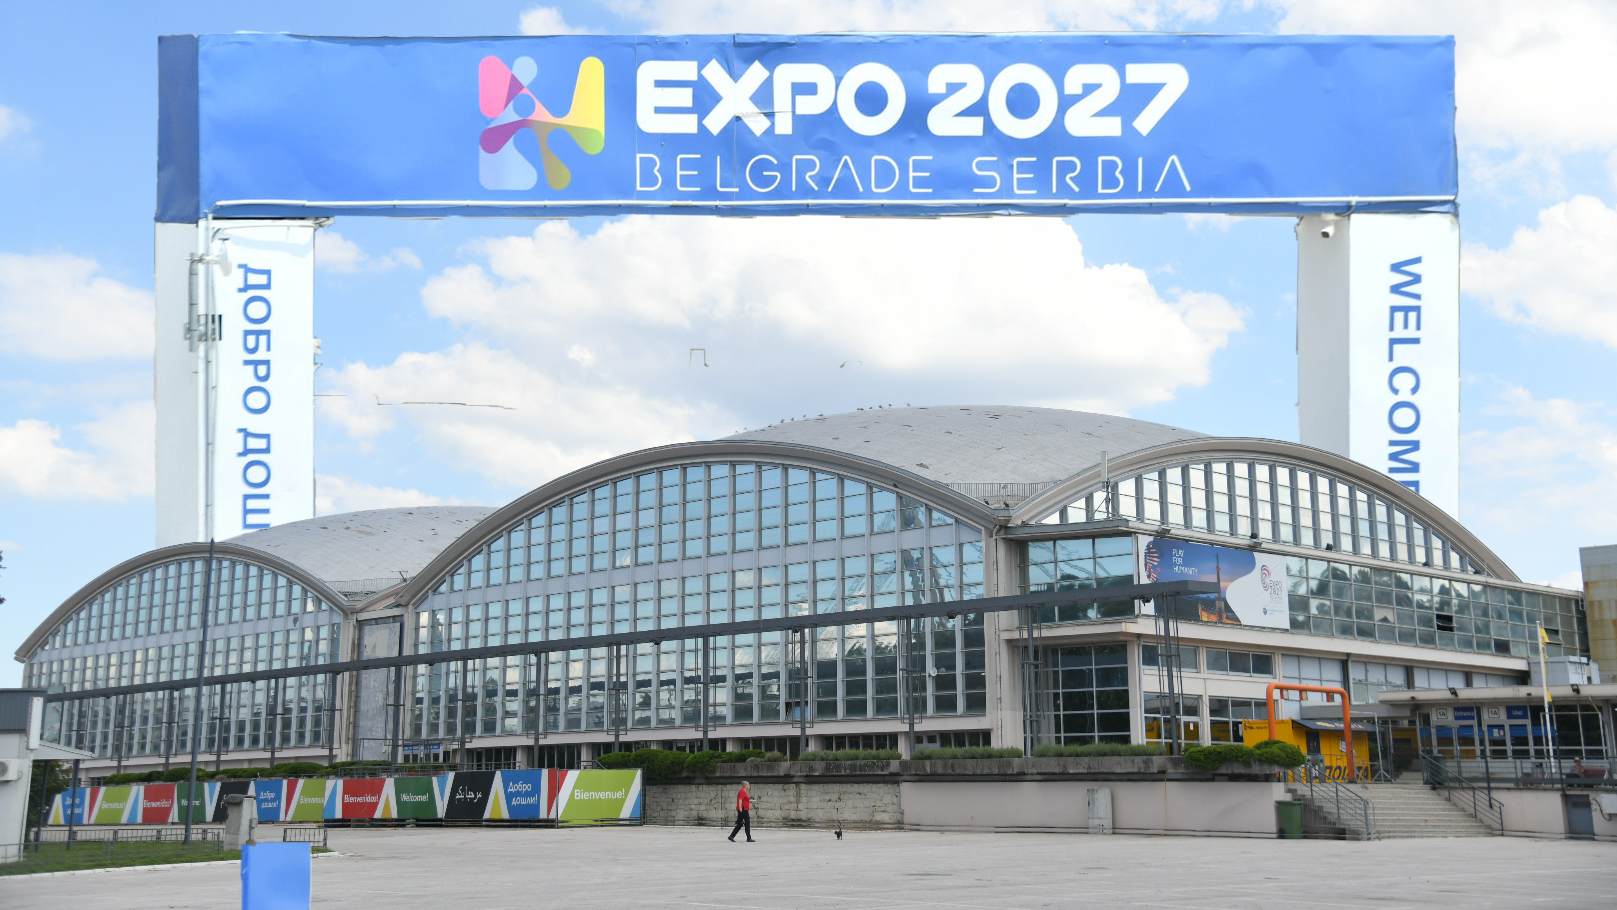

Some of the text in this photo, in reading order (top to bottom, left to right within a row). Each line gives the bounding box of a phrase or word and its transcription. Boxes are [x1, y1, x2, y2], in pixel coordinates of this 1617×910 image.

[636, 59, 1190, 139] EXPO 2027
[636, 154, 1192, 196] BELGRADE SERBIA
[236, 263, 272, 415] ДОБРО
[1172, 548, 1184, 557] PLAY
[1172, 556, 1183, 565] FOR
[1173, 566, 1198, 576] HUMANITY
[507, 781, 532, 794] Добро
[260, 791, 276, 800] Добро
[344, 793, 379, 803] Bienvenidos!
[400, 792, 429, 802] Welcome!
[574, 788, 626, 801] Bienvenue!
[143, 799, 172, 808] Bienvenidos!
[511, 794, 538, 806] дошли!
